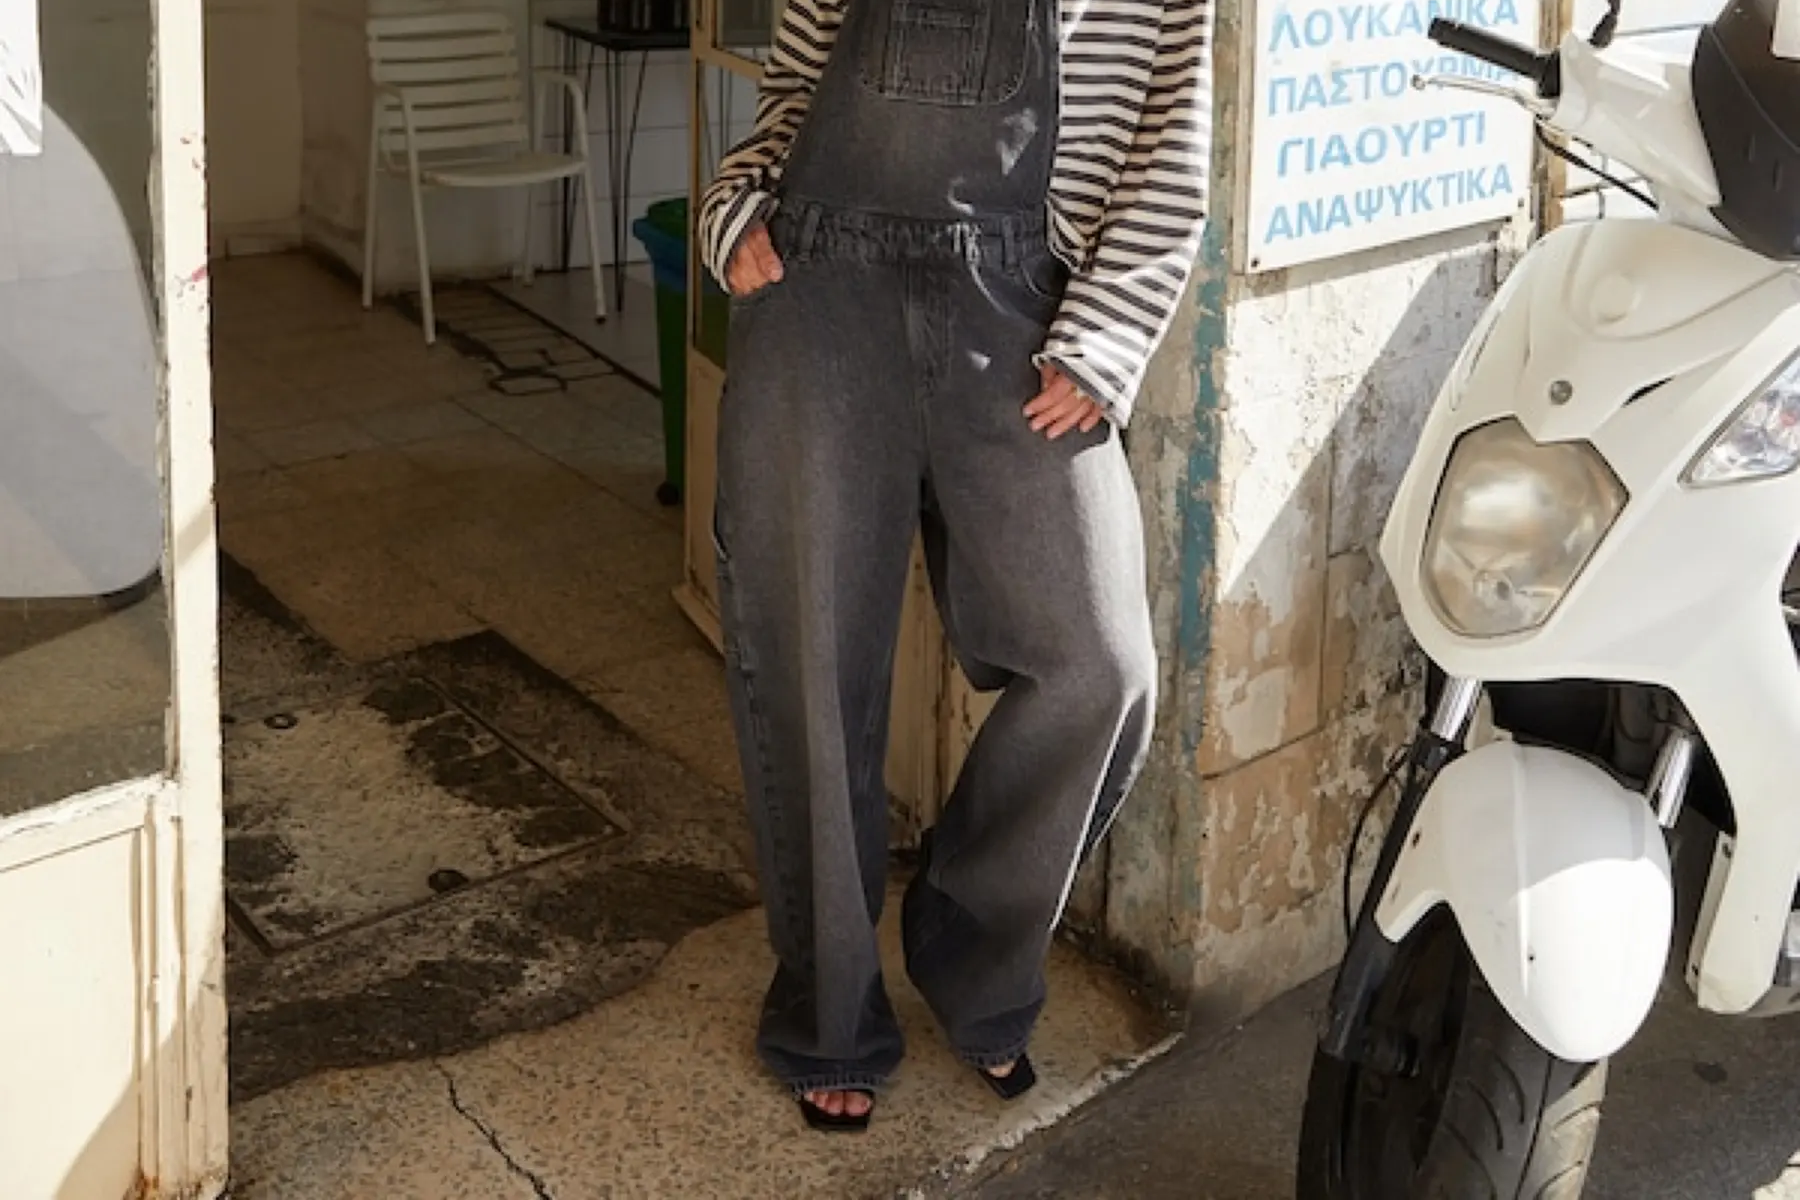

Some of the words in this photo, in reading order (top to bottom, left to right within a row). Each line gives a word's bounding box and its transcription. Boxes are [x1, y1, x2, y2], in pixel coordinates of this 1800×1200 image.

[1268, 56, 1521, 117] ΠΑΣΤΟΥΡΜ
[1277, 111, 1486, 177] ΓΙΑΟΥΡΤΙ
[1264, 163, 1513, 244] ΑΝΑΨΥΚΤΙΚΑ
